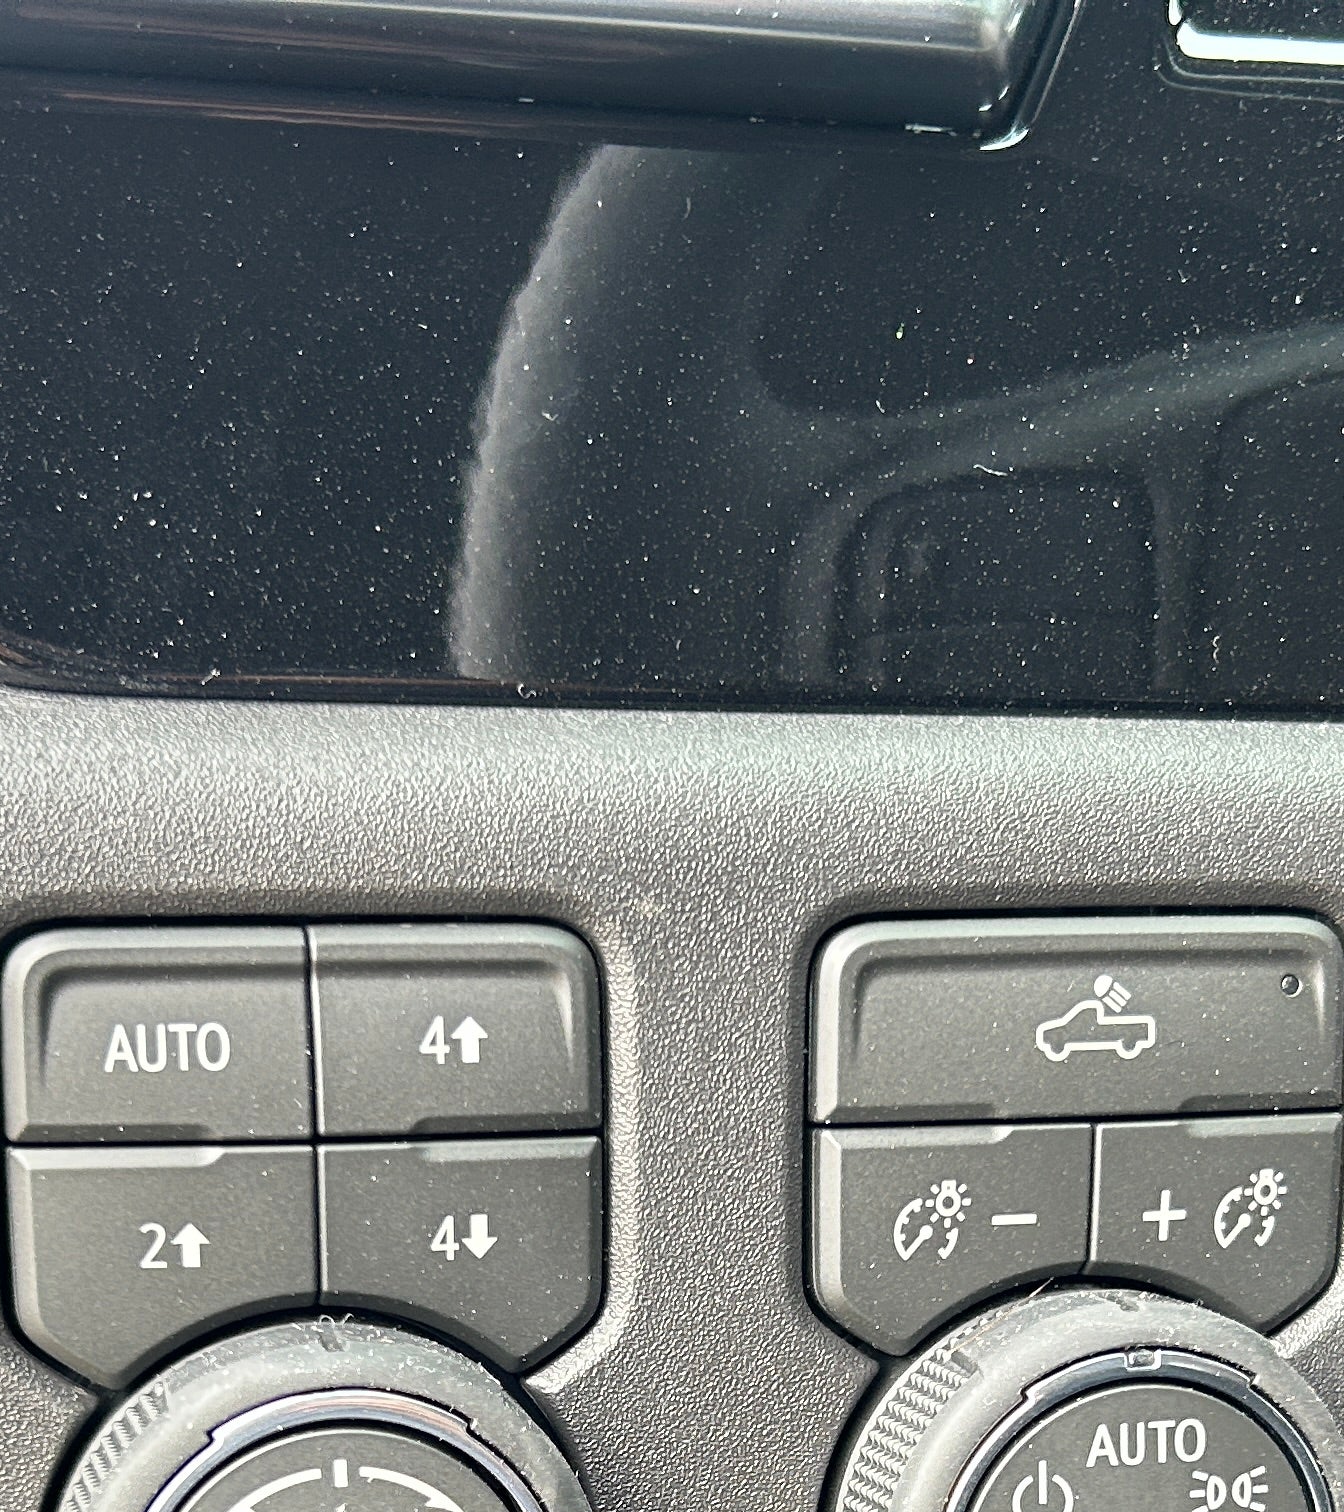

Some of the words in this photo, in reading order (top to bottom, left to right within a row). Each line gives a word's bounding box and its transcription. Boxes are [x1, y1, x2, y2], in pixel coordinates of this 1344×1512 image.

[105, 1023, 230, 1072] AUTO
[419, 1016, 450, 1064] 4
[139, 1223, 167, 1268] 2
[430, 1215, 459, 1260] 4
[1086, 1419, 1205, 1467] AUTO
